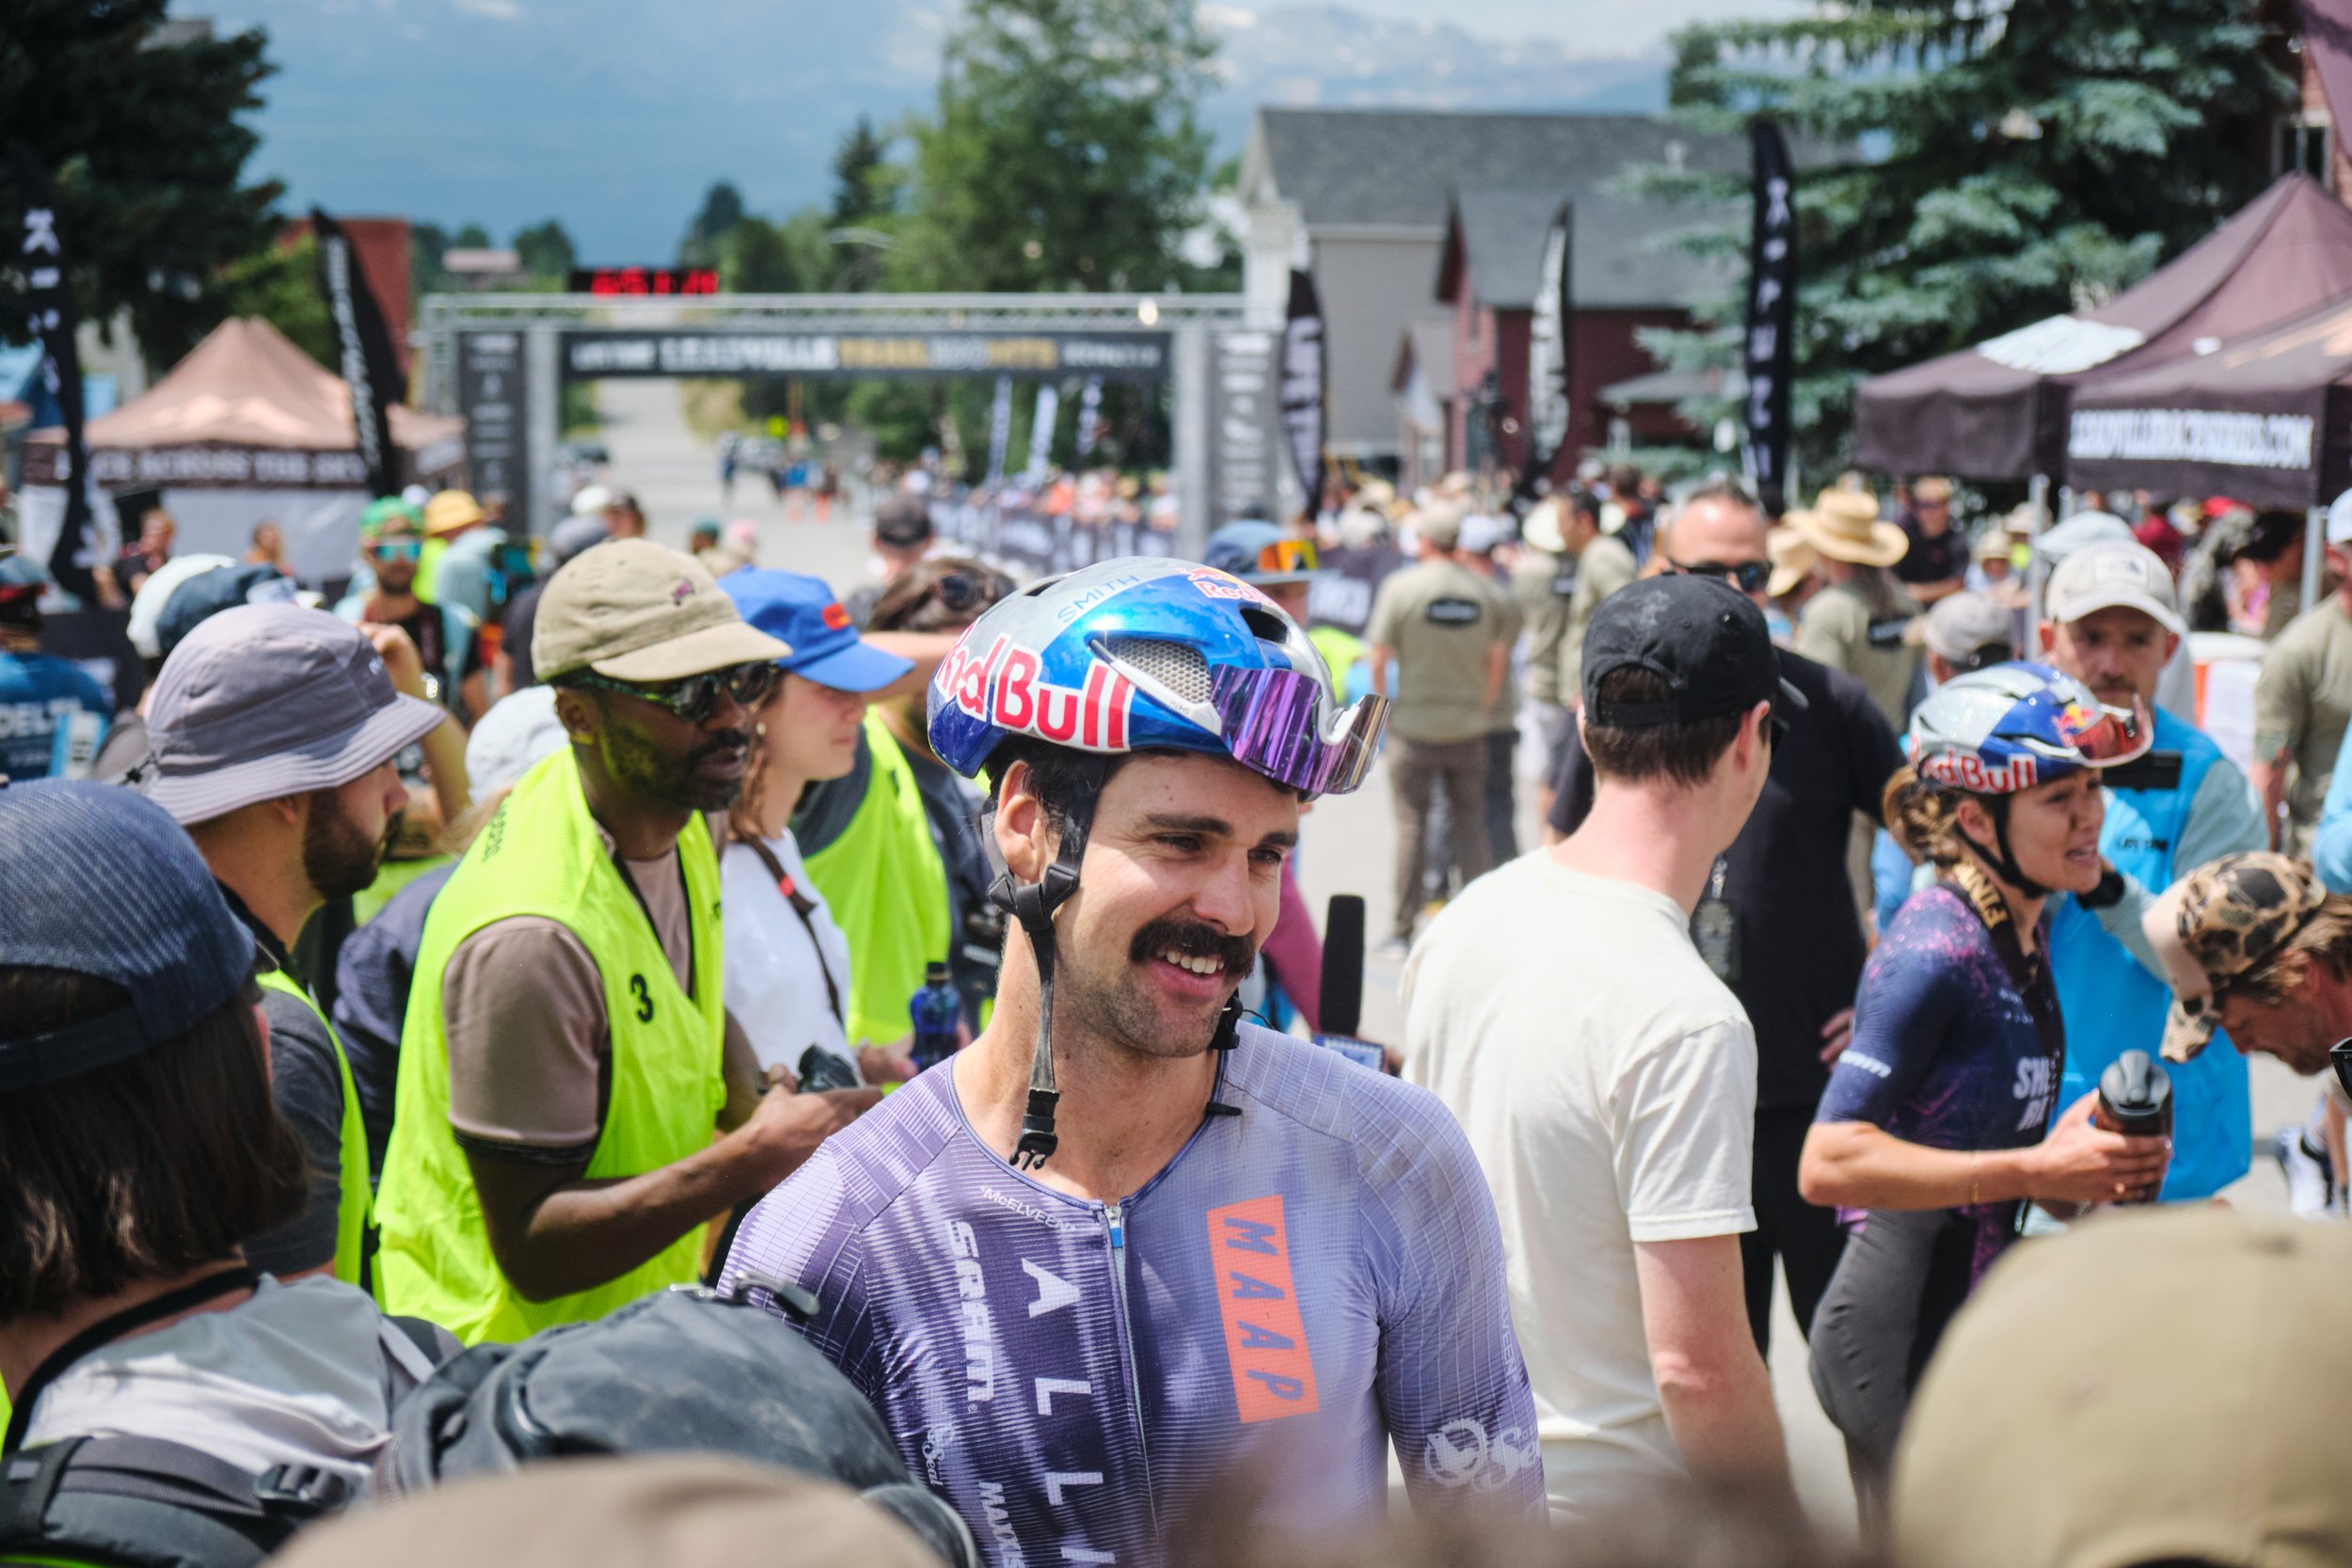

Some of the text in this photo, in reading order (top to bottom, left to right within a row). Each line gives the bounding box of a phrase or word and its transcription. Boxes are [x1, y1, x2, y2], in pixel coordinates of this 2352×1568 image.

[1057, 575, 1140, 624] SMITH
[992, 643, 1136, 752] Bull
[1961, 753, 2038, 795] Bull
[630, 973, 654, 1023] 3
[1224, 1216, 1305, 1402] MAAP
